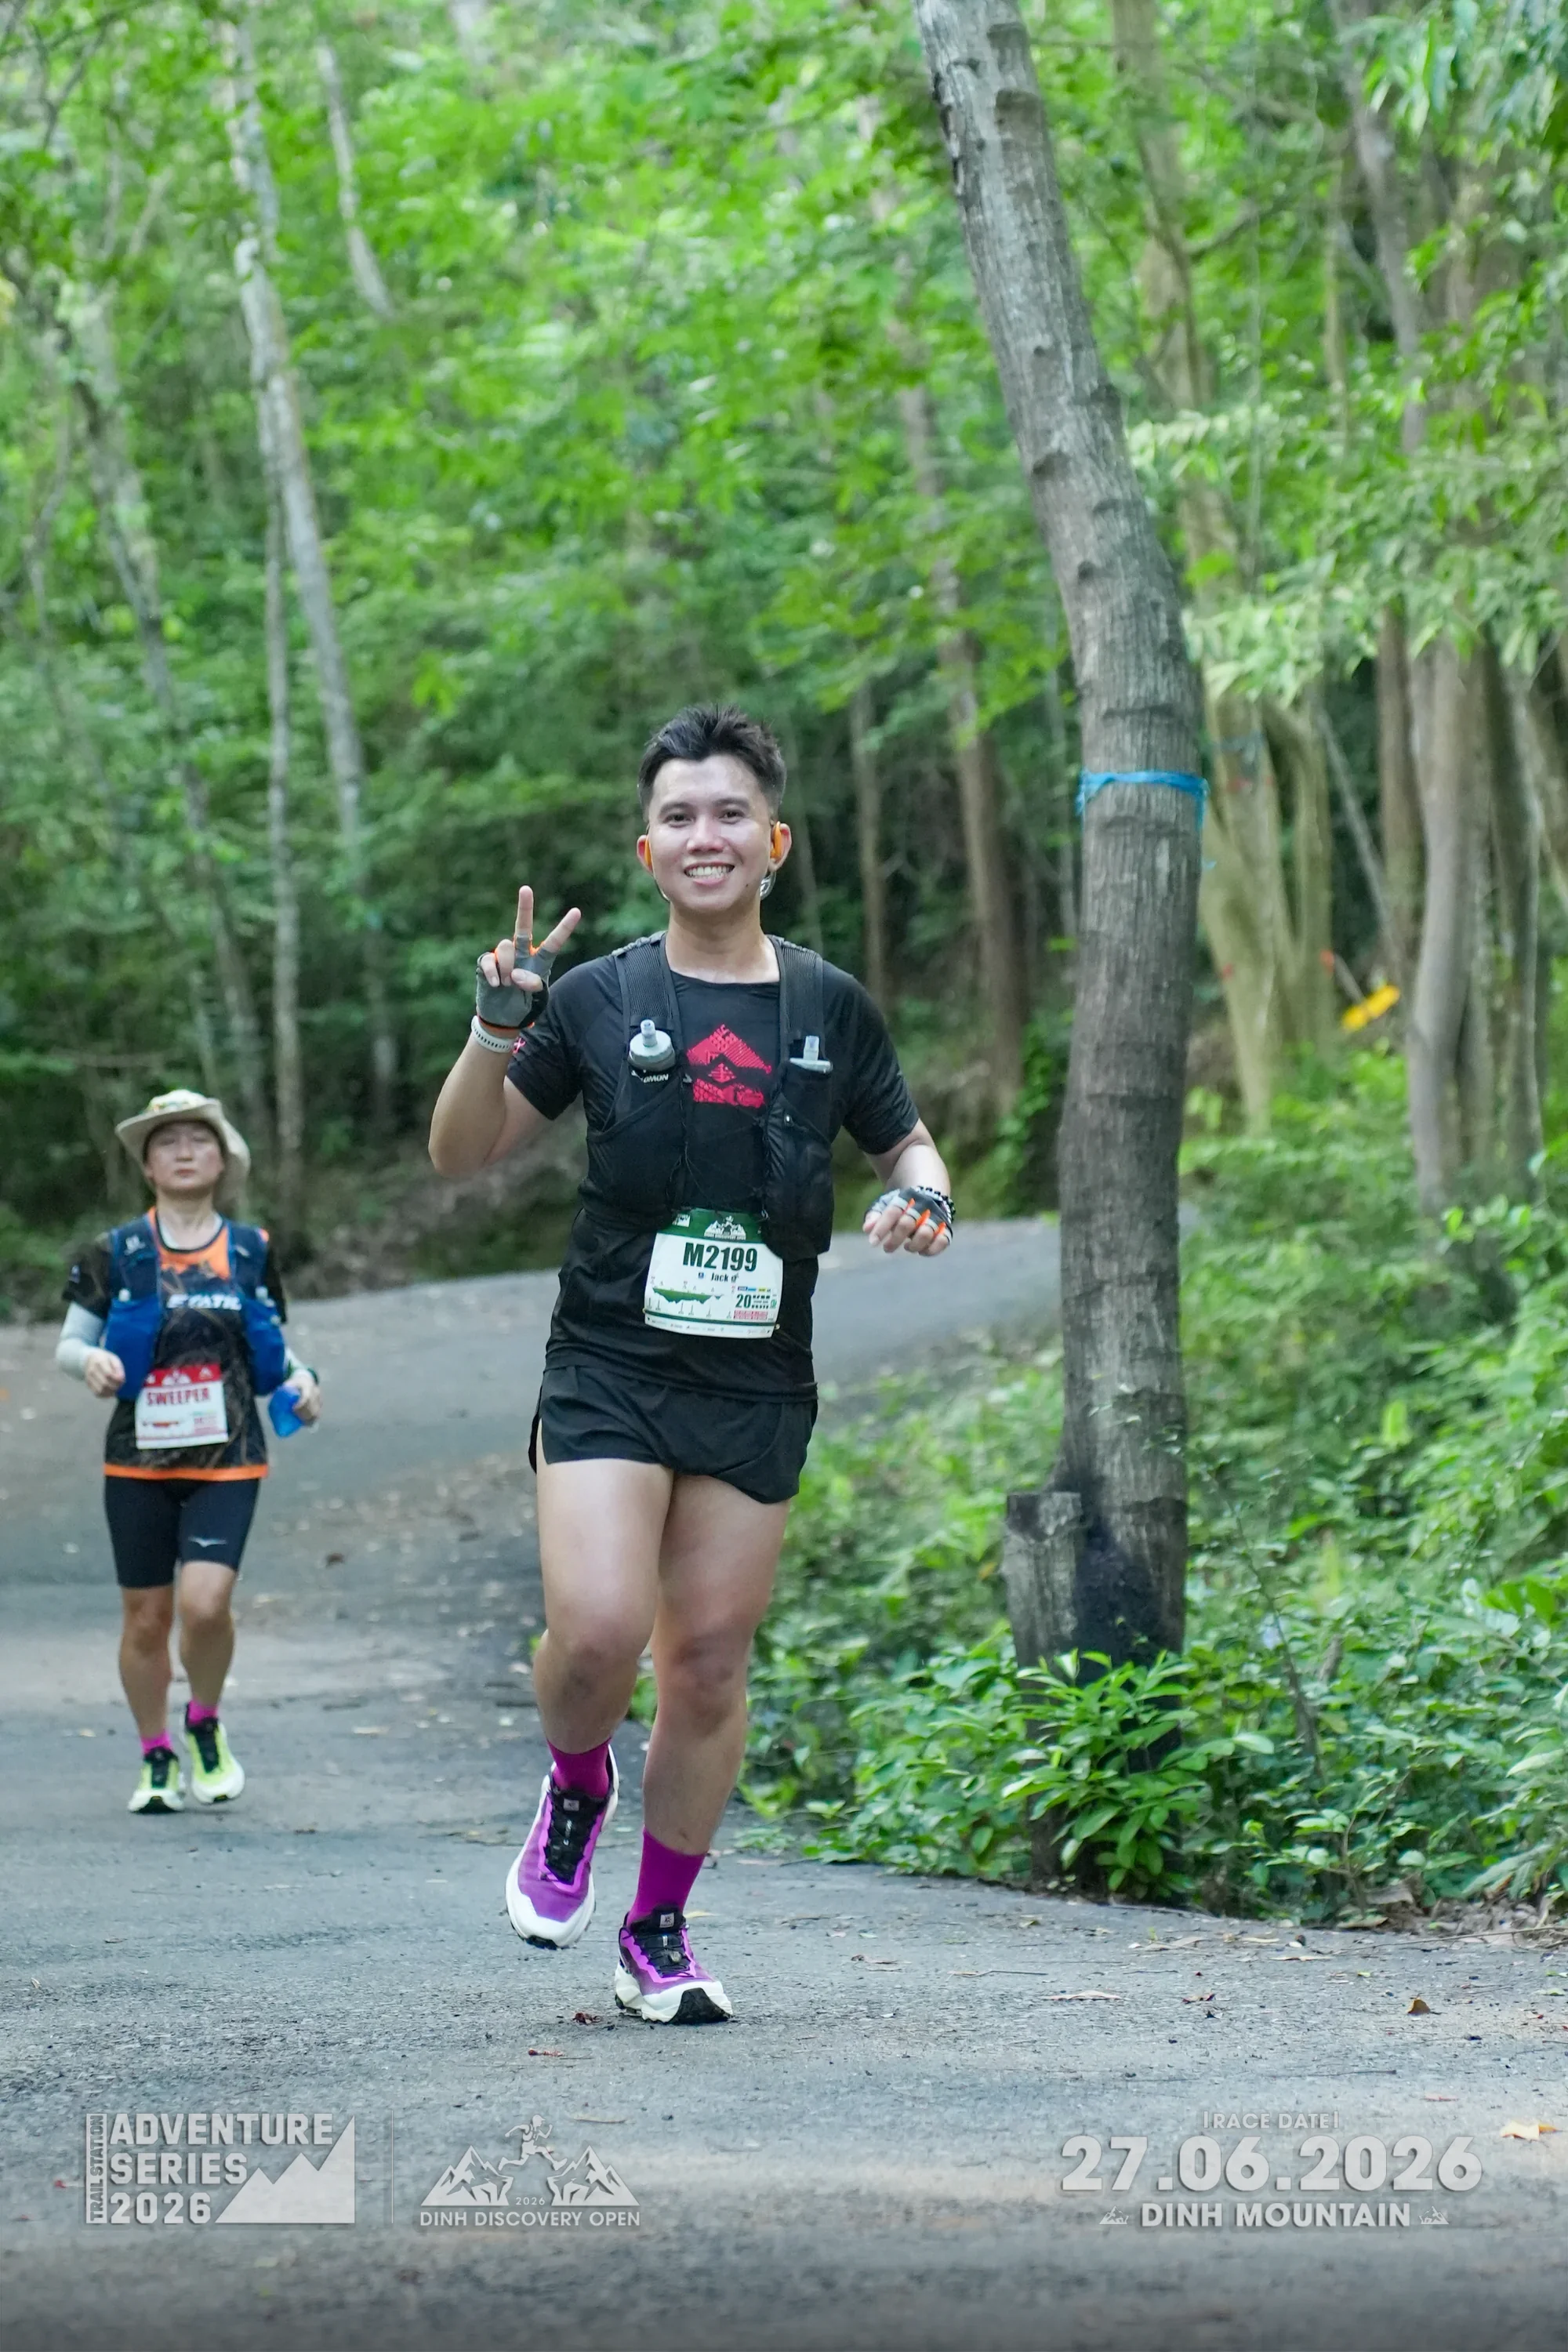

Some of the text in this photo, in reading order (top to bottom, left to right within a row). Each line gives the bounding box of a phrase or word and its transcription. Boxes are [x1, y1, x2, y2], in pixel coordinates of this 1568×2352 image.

[683, 1242, 757, 1272] M2199
[710, 1272, 728, 1282] Jack
[735, 1294, 752, 1308] 20
